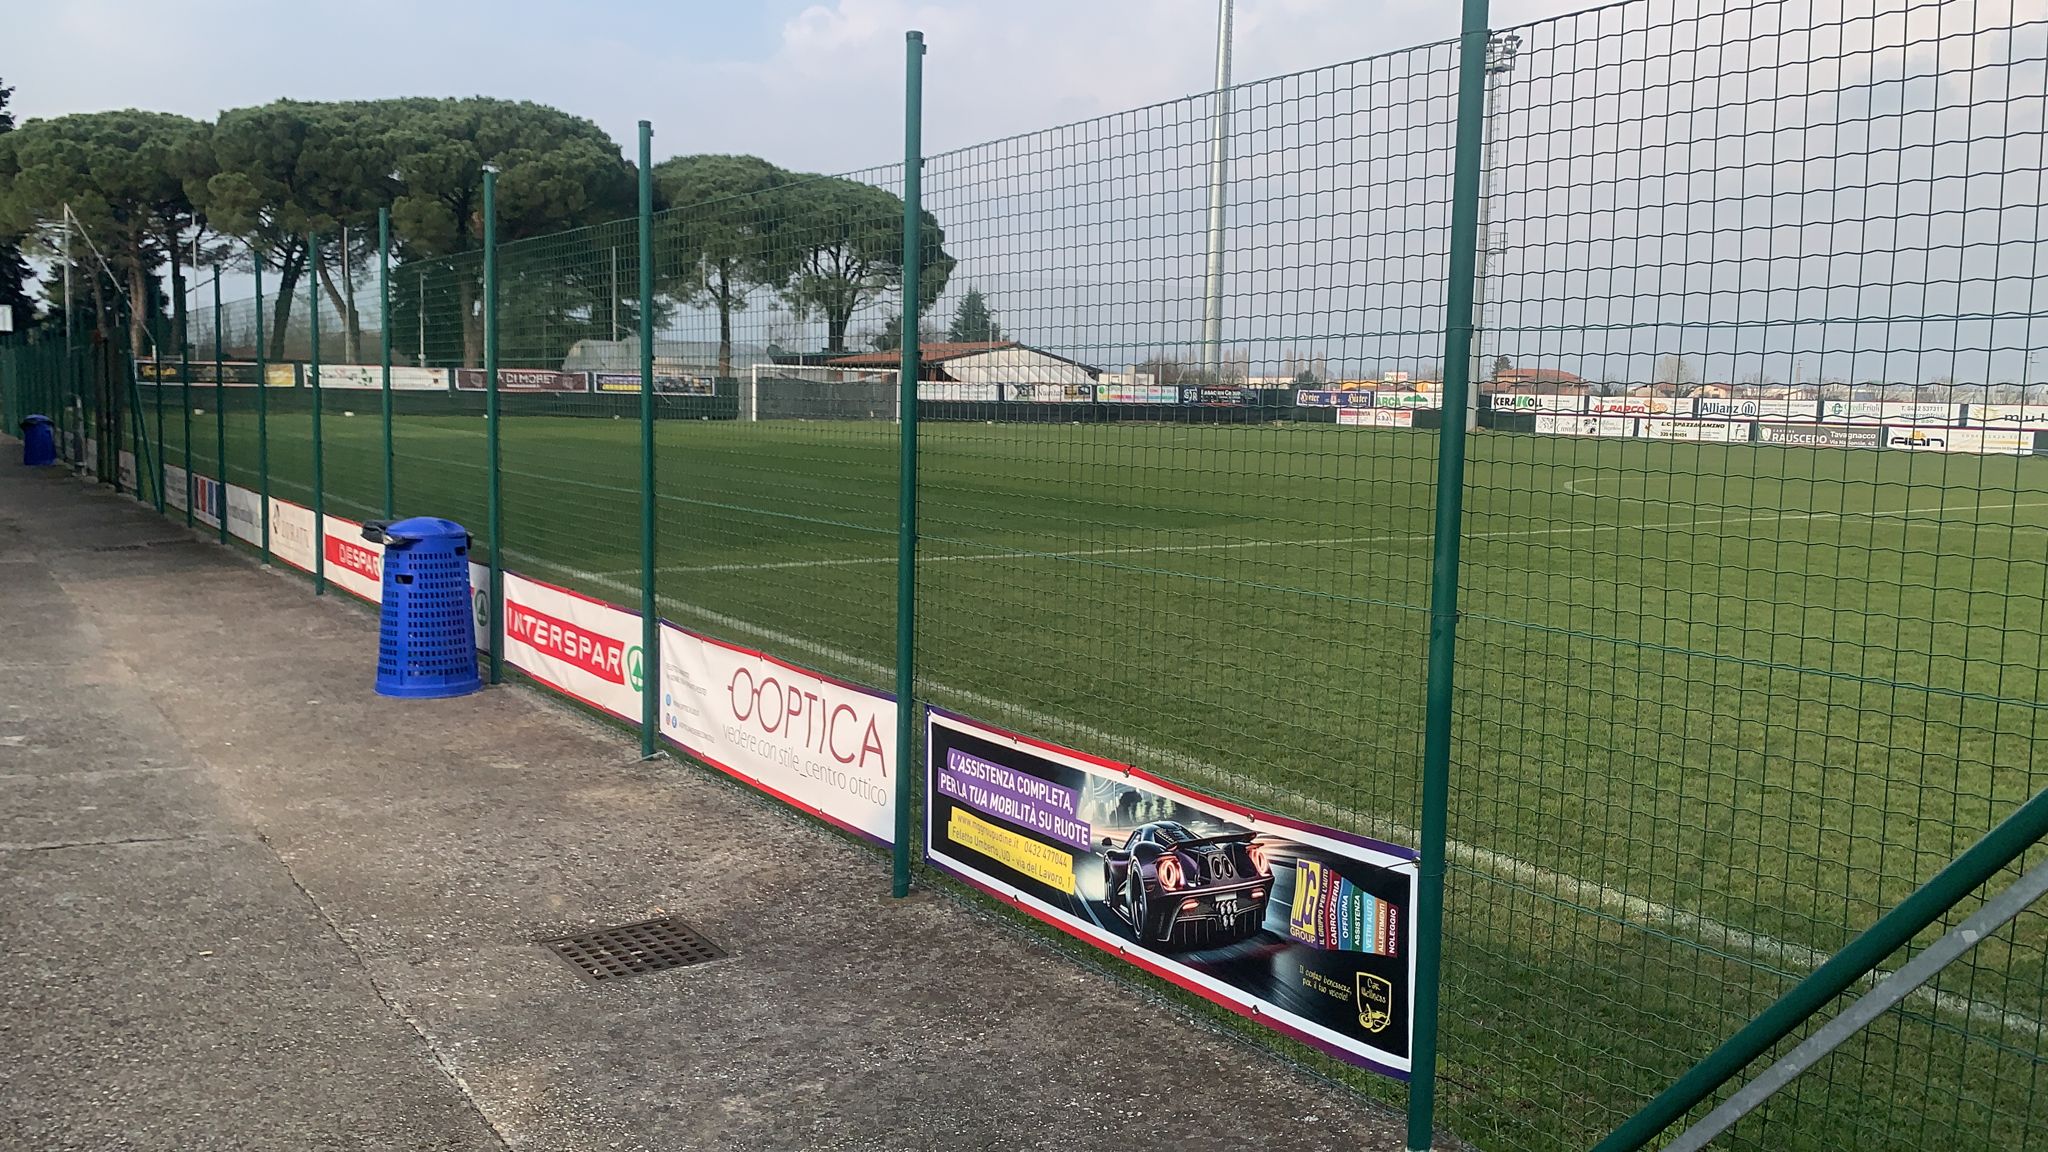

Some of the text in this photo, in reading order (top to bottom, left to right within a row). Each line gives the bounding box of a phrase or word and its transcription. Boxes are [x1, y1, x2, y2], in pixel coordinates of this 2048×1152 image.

[1494, 395, 1543, 407] KERAKOLL
[1701, 402, 1739, 414] Allianz
[1772, 433, 1828, 444] RAUSCEDO
[1830, 431, 1876, 441] Tavagnacco
[507, 606, 621, 676] INTERSPAR
[723, 723, 757, 752] vedere
[758, 738, 777, 760] con
[849, 776, 887, 807] ottico
[950, 752, 1075, 815] L'ASSISTENZA COMPLETA,
[940, 773, 1089, 846] PER LA TUA MOBILITÀ SU RUOTE
[1024, 840, 1041, 858] 0432
[1016, 857, 1026, 870] via
[1027, 862, 1038, 875] del
[1329, 880, 1340, 945] CARROZZERIA
[1341, 895, 1349, 939] OFFICINA
[1290, 926, 1316, 944] GROUP
[1388, 908, 1396, 954] NOLEGGIO
